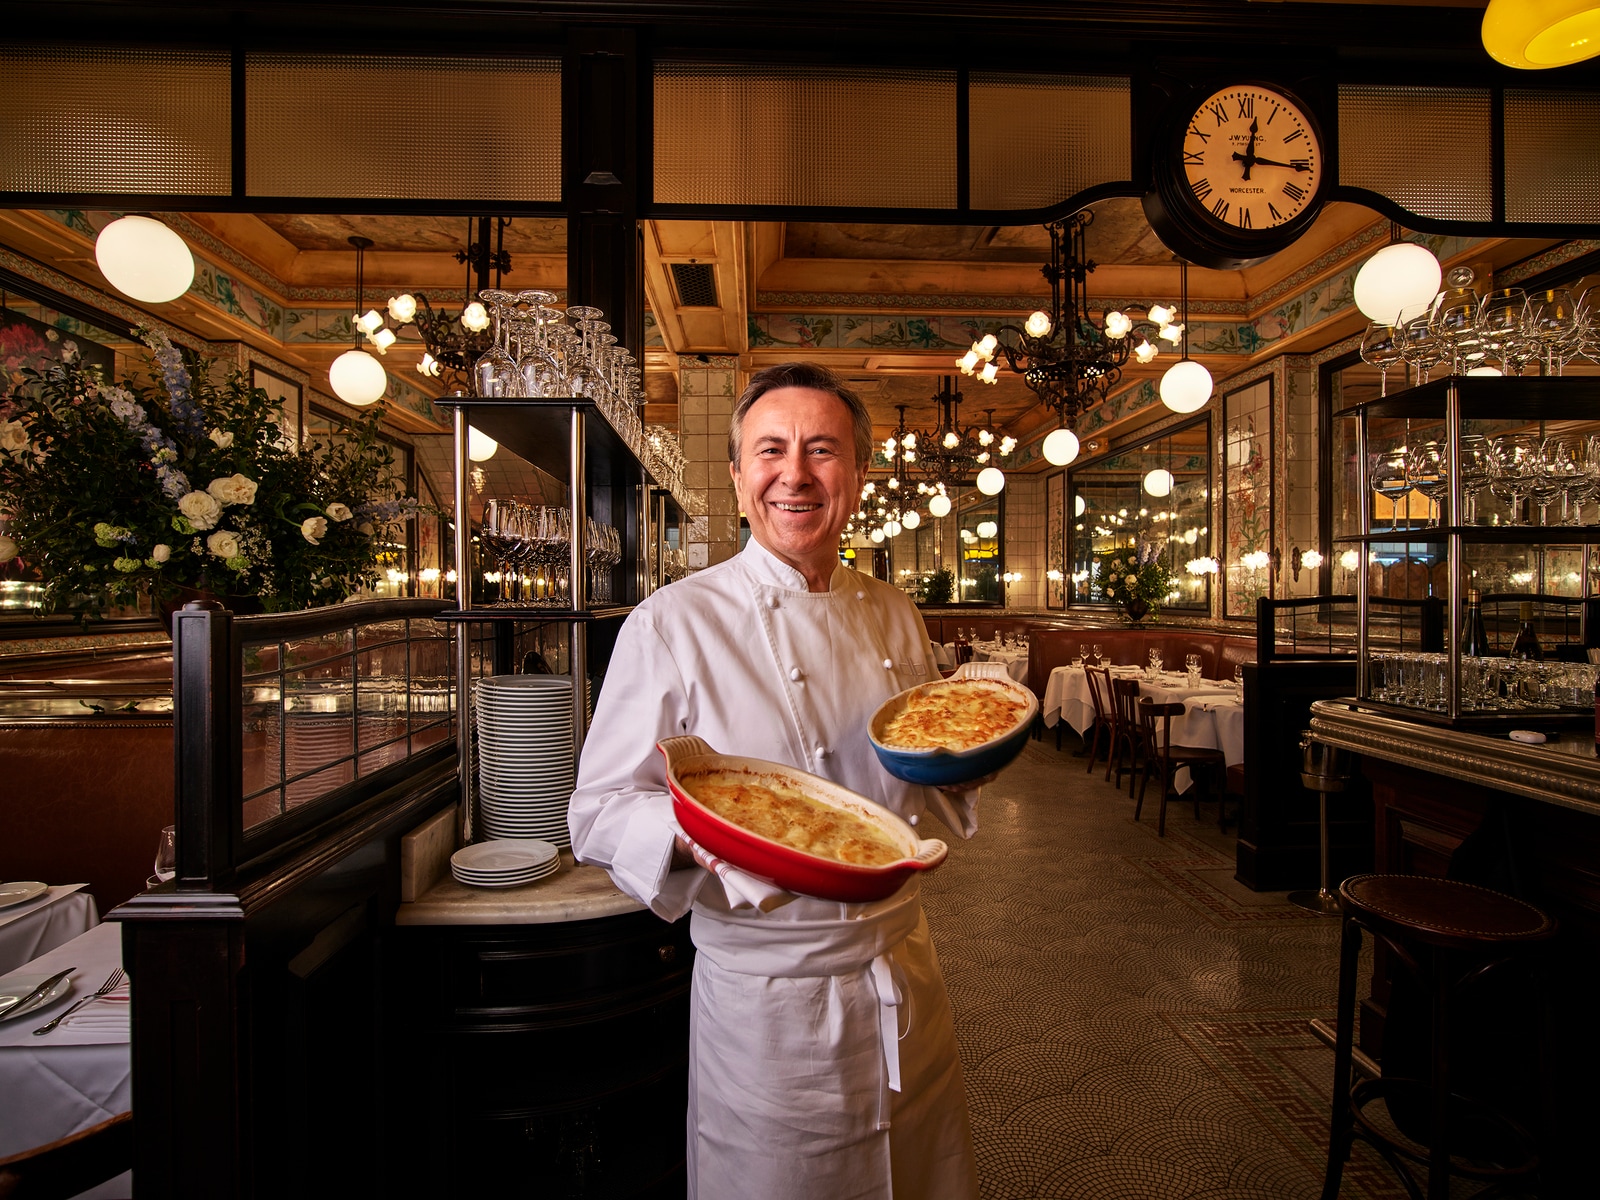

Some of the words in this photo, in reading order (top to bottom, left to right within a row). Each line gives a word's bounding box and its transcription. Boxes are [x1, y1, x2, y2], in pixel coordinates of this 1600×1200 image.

[1210, 103, 1229, 127] XI
[1238, 98, 1254, 119] XII
[1267, 106, 1278, 125] I
[1189, 125, 1211, 144] X
[1282, 129, 1303, 144] II
[1184, 151, 1205, 166] IX
[1211, 198, 1230, 220] VII
[1267, 202, 1282, 221] V
